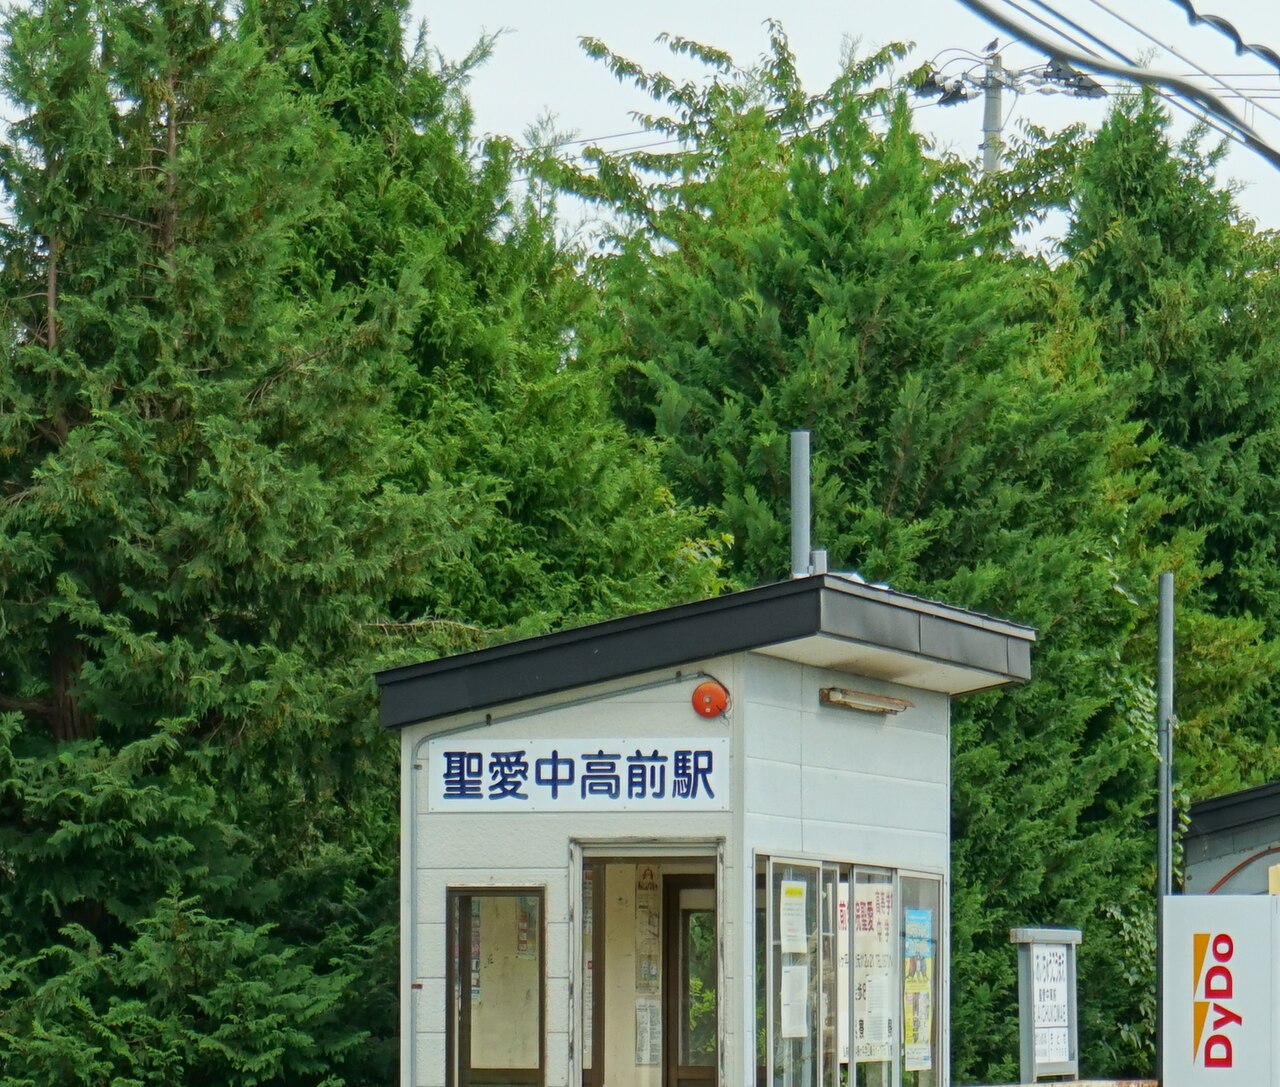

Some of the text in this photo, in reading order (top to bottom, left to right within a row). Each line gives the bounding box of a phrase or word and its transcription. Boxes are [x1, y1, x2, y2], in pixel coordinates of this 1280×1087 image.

[442, 749, 716, 800] 聖愛中高前駅
[1204, 933, 1242, 1068] DyDo
